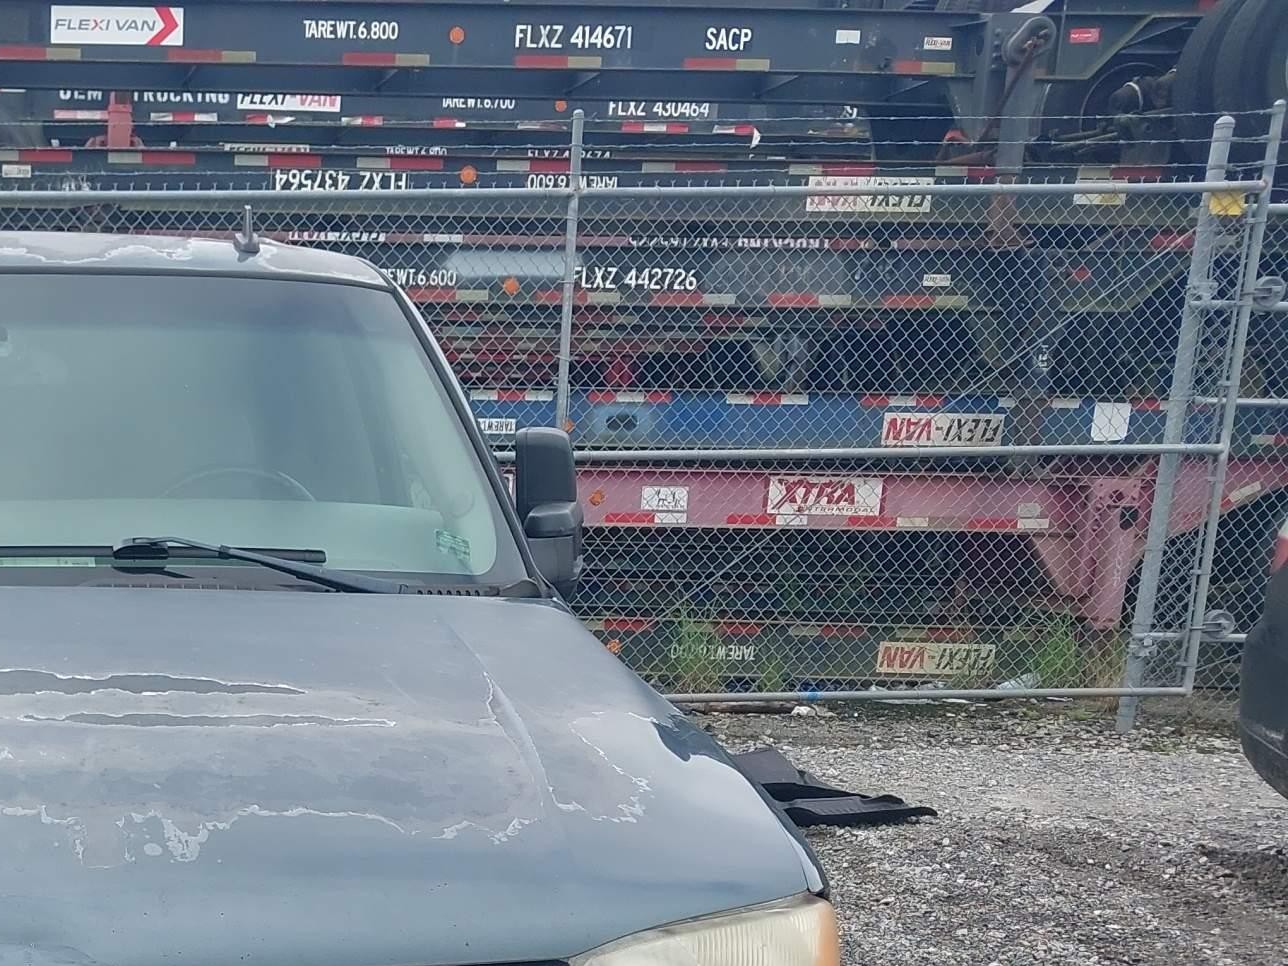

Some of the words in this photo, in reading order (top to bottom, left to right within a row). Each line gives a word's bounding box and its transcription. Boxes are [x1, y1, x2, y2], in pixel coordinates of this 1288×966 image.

[54, 19, 110, 31] FLEXI
[116, 19, 158, 32] VAN
[515, 25, 562, 48] FLXZ
[570, 25, 633, 49] 414671
[705, 27, 752, 51] SACP
[608, 101, 646, 116] FLXZ
[653, 102, 709, 117] 430464
[275, 169, 350, 190] 437564
[358, 171, 408, 190] FLXZ
[624, 267, 697, 290] 442726
[773, 479, 856, 510] XTRA
